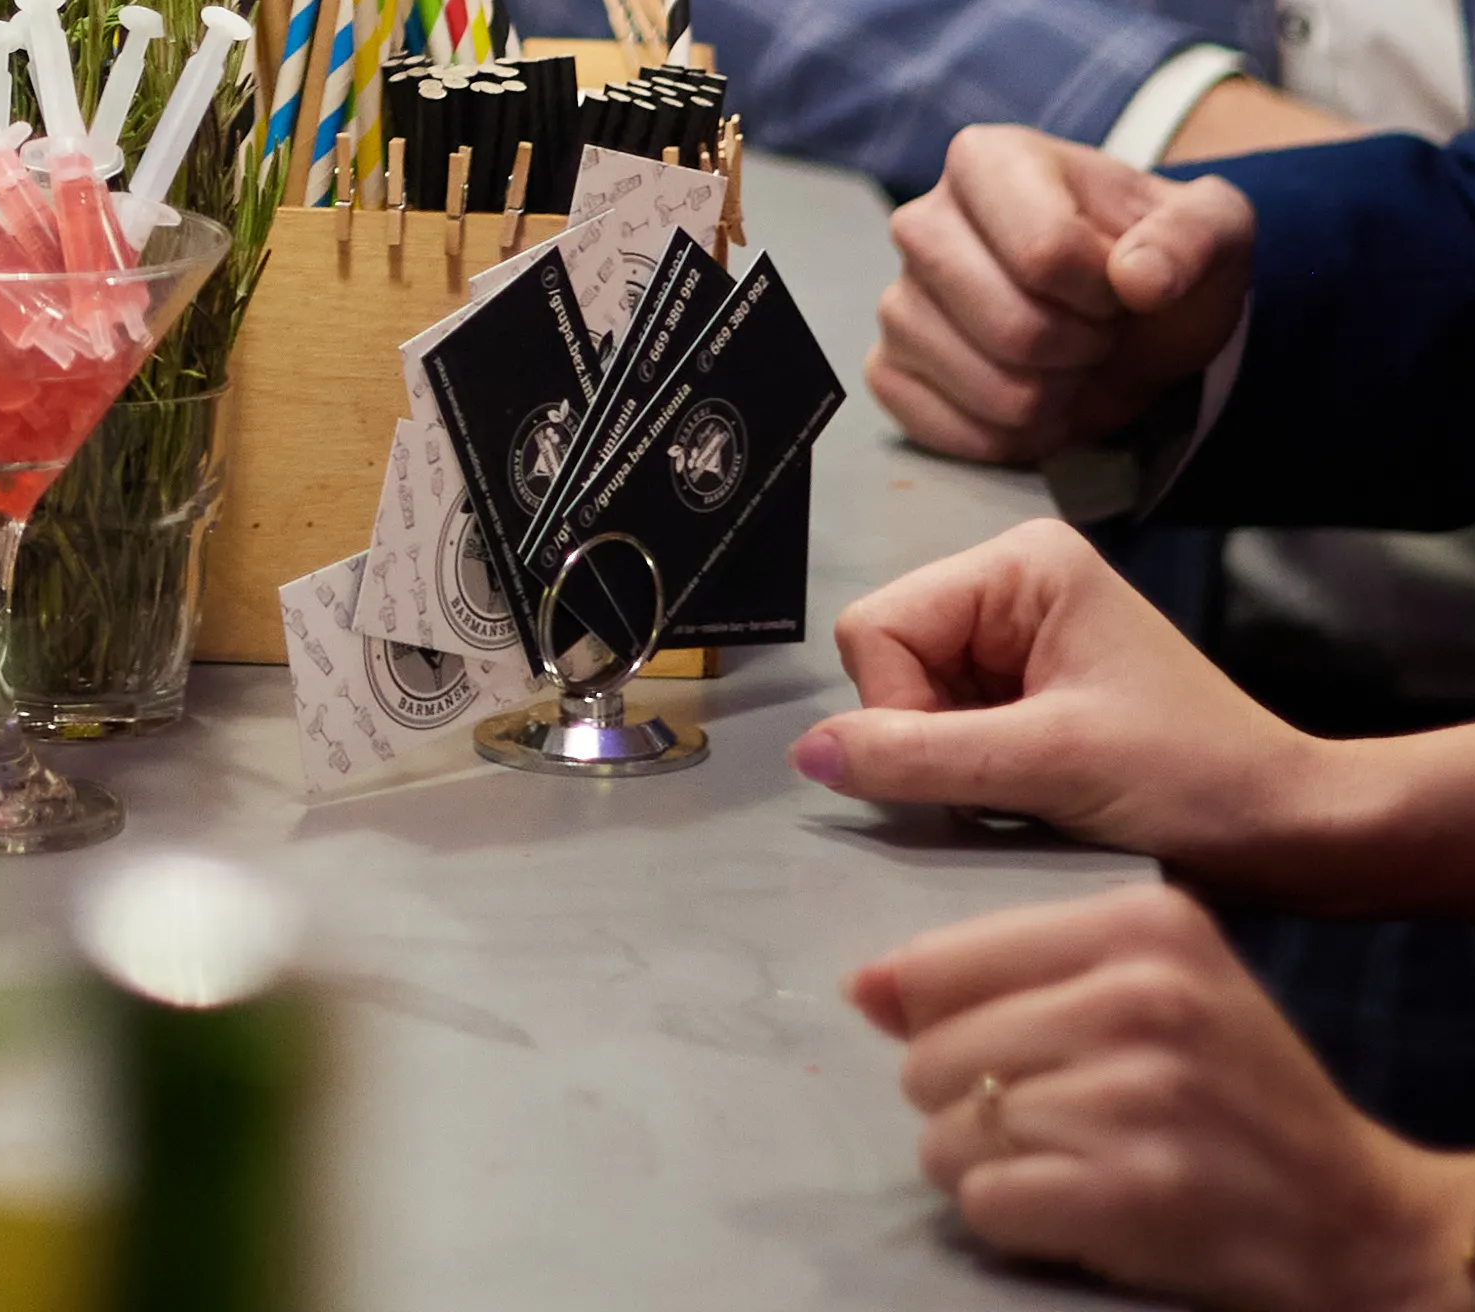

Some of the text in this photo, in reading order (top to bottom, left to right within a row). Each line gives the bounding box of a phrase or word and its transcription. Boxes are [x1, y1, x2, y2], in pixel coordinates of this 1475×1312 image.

[547, 288, 595, 406] /grupa.bez.im
[648, 330, 669, 362] 669
[665, 299, 685, 331] 380
[680, 268, 701, 300] 992
[710, 274, 770, 355] 669 380 992
